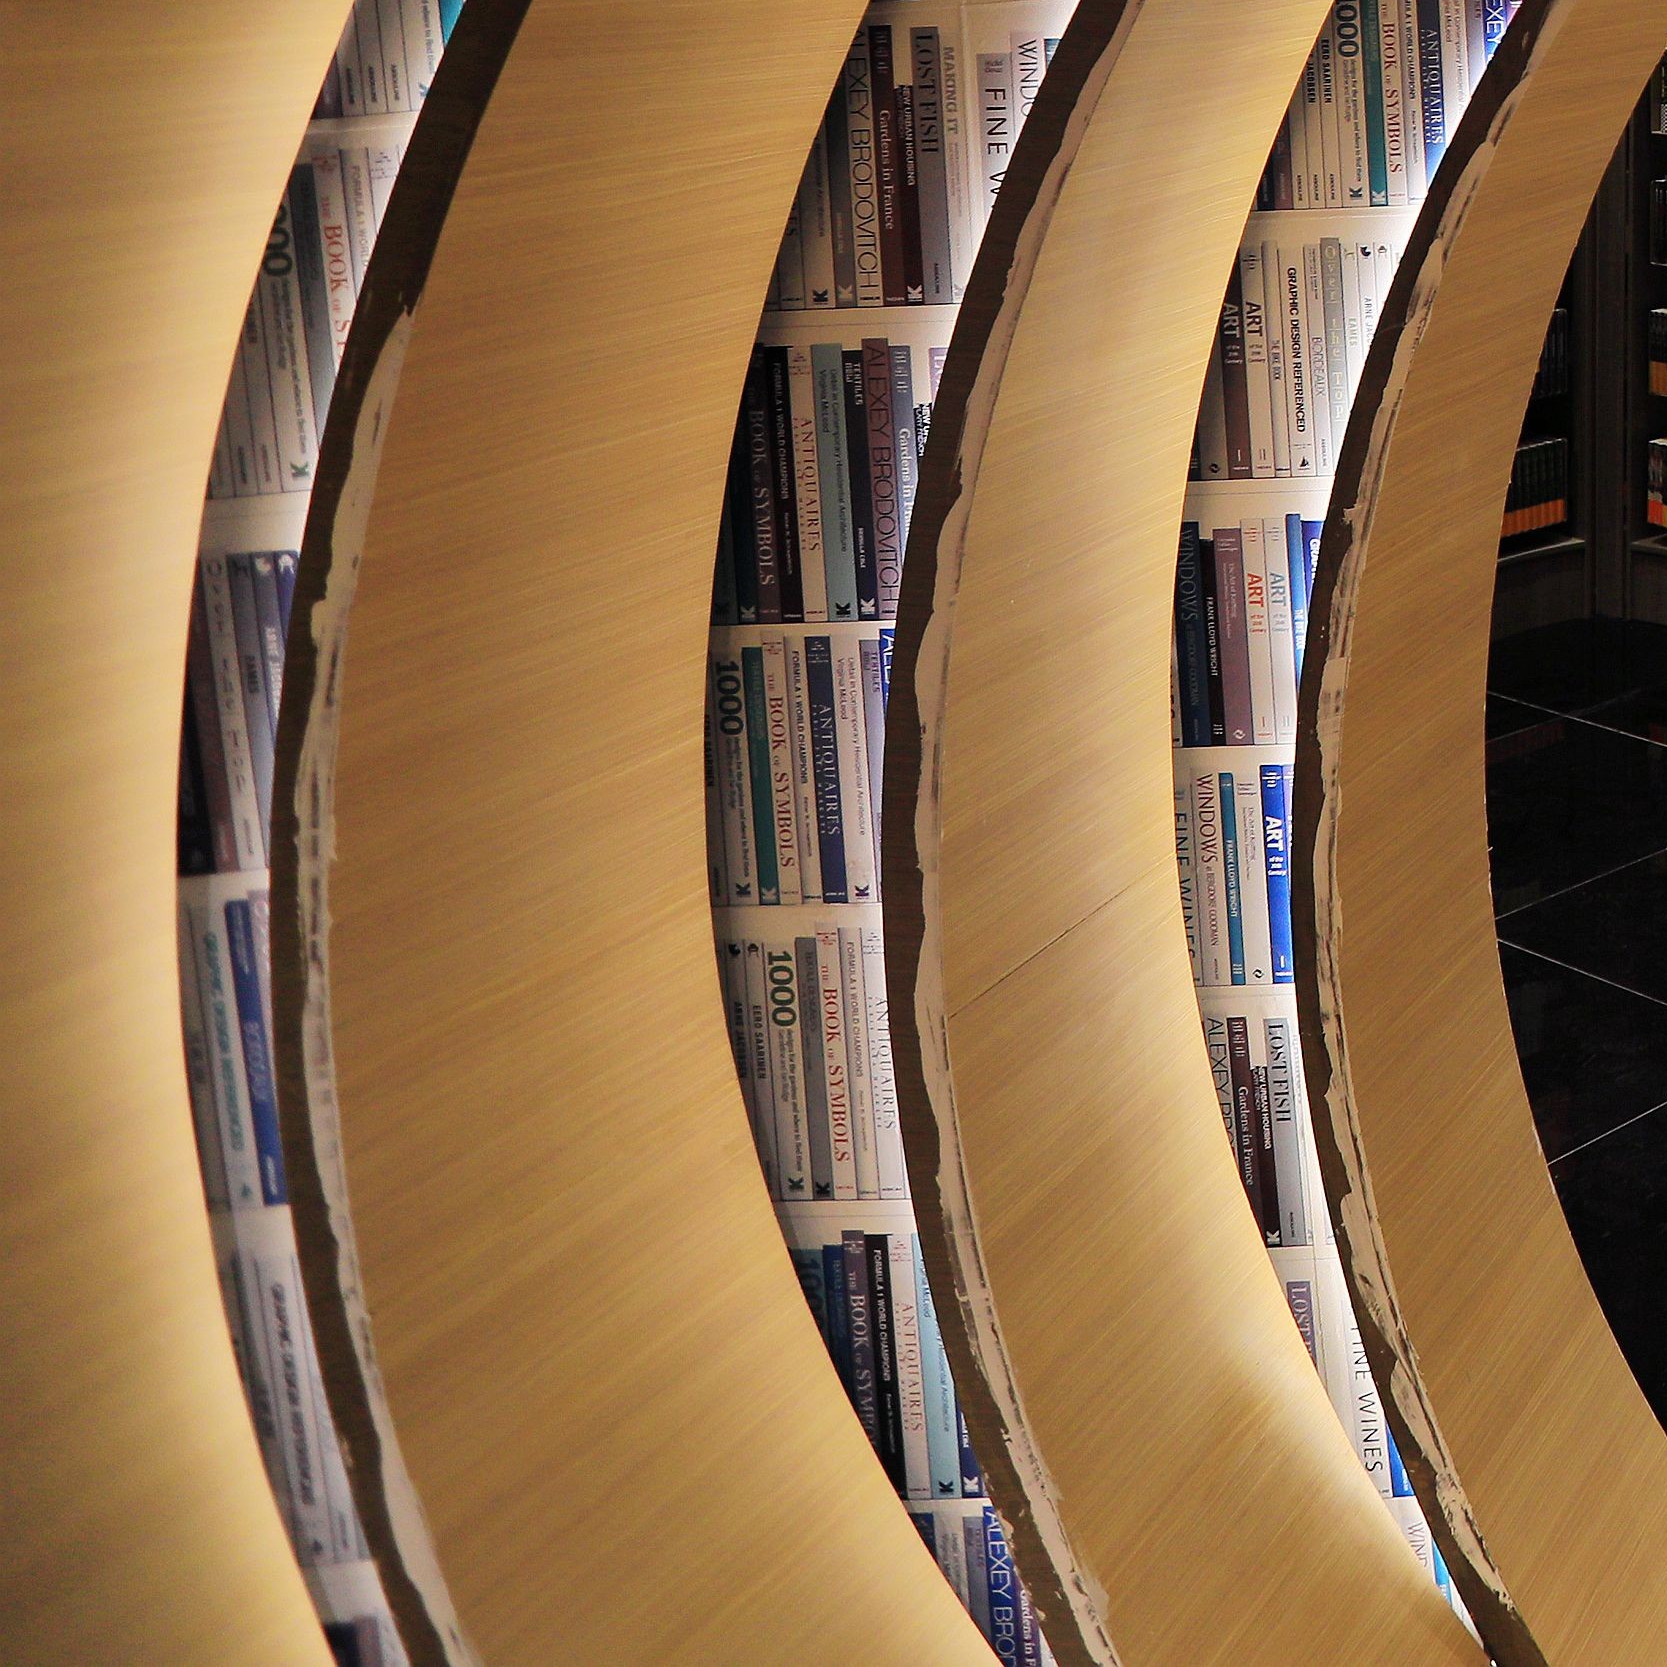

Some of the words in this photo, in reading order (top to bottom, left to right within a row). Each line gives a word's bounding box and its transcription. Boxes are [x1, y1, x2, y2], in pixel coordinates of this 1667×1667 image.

[916, 35, 935, 94] LOST
[1382, 23, 1398, 71] BOOK
[1426, 30, 1443, 144] ANTIQUAIRES
[880, 110, 893, 165] Gardens
[919, 103, 939, 154] FISH
[985, 88, 1008, 155] FINE
[1385, 89, 1402, 173] SYMBOLS
[851, 129, 879, 289] BRODOVITCH
[883, 185, 895, 231] France
[322, 225, 348, 292] BOOK
[1246, 302, 1262, 337] ART
[1288, 268, 1298, 323] GRAPHIC
[1291, 326, 1301, 359] DESIGN
[867, 346, 890, 433] ALEXEY
[1292, 362, 1305, 432] REFERENCED
[752, 410, 768, 465] BOOK
[776, 415, 786, 446] WORLD
[899, 428, 912, 484] Gardens
[778, 449, 788, 500] CHAMPIONS
[801, 419, 821, 553] ANTIQUAIRES
[755, 487, 775, 585] SYMBOLS
[871, 446, 900, 603] BRODOVITCH
[1247, 573, 1264, 607] ART
[1270, 573, 1286, 606] ART
[715, 661, 744, 734] 1000
[769, 696, 787, 751] BOOK
[820, 704, 842, 837] ANTIQUAIRES
[773, 771, 796, 868] SYMBOLS
[1197, 774, 1217, 863] WINDOWS
[1266, 816, 1282, 851] ART
[767, 950, 797, 1027] 1000
[851, 992, 861, 1024] WORLD
[822, 988, 842, 1045] BOOK
[755, 1034, 767, 1080] SAARINEN
[853, 1026, 863, 1078] CHAMPIONS
[874, 997, 896, 1131] ANTIQUAIRES
[1268, 1024, 1284, 1075] LOST
[828, 1065, 851, 1163] SYMBOLS
[1237, 1085, 1251, 1130] Gardens
[1273, 1079, 1291, 1122] FISH
[1263, 1114, 1272, 1150] HOUSING
[1243, 1148, 1254, 1186] France
[850, 1295, 869, 1347] BOOK
[901, 1303, 923, 1432] ANTIQUAIRES
[1357, 1392, 1383, 1474] WINES
[986, 1509, 1011, 1600] ALEXEY
